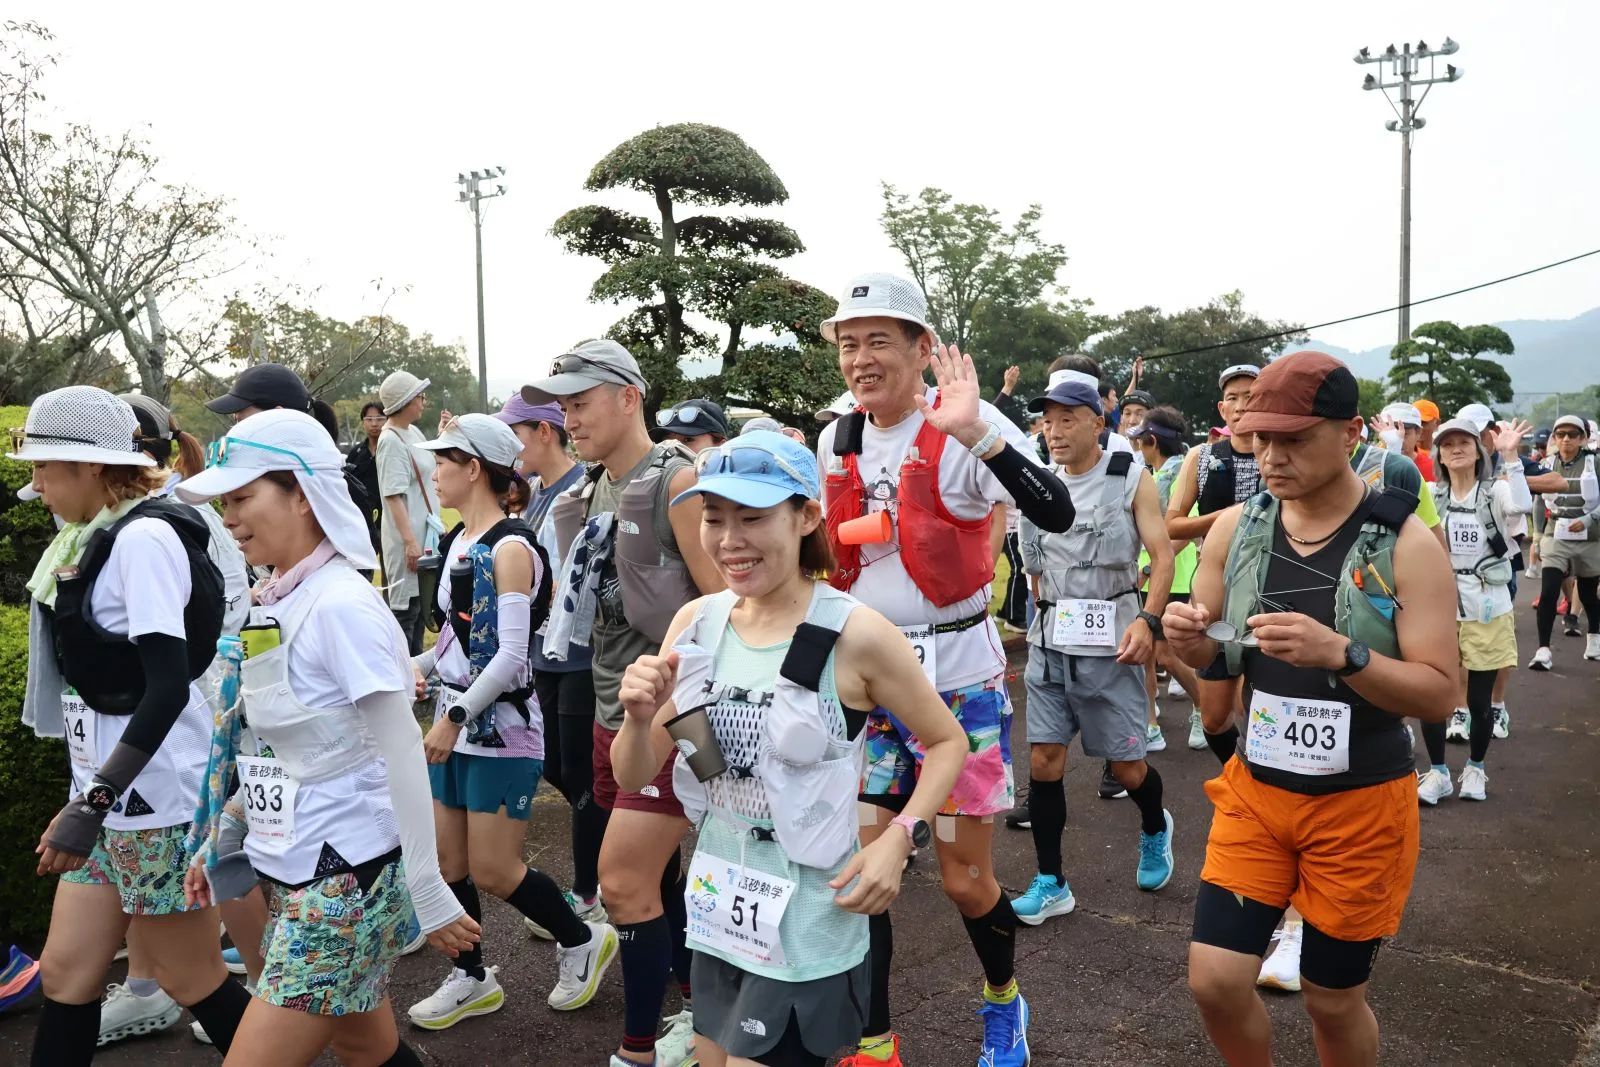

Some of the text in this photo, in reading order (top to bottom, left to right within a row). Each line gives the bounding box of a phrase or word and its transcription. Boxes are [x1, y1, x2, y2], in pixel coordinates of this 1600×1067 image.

[1454, 531, 1478, 543] 188
[1084, 613, 1105, 629] 83
[1296, 705, 1343, 720] 高砂熱学
[1284, 721, 1337, 751] 403
[243, 782, 284, 813] 333
[738, 876, 783, 899] 高砂熱学
[324, 901, 344, 912] WHY
[730, 895, 759, 932] 51
